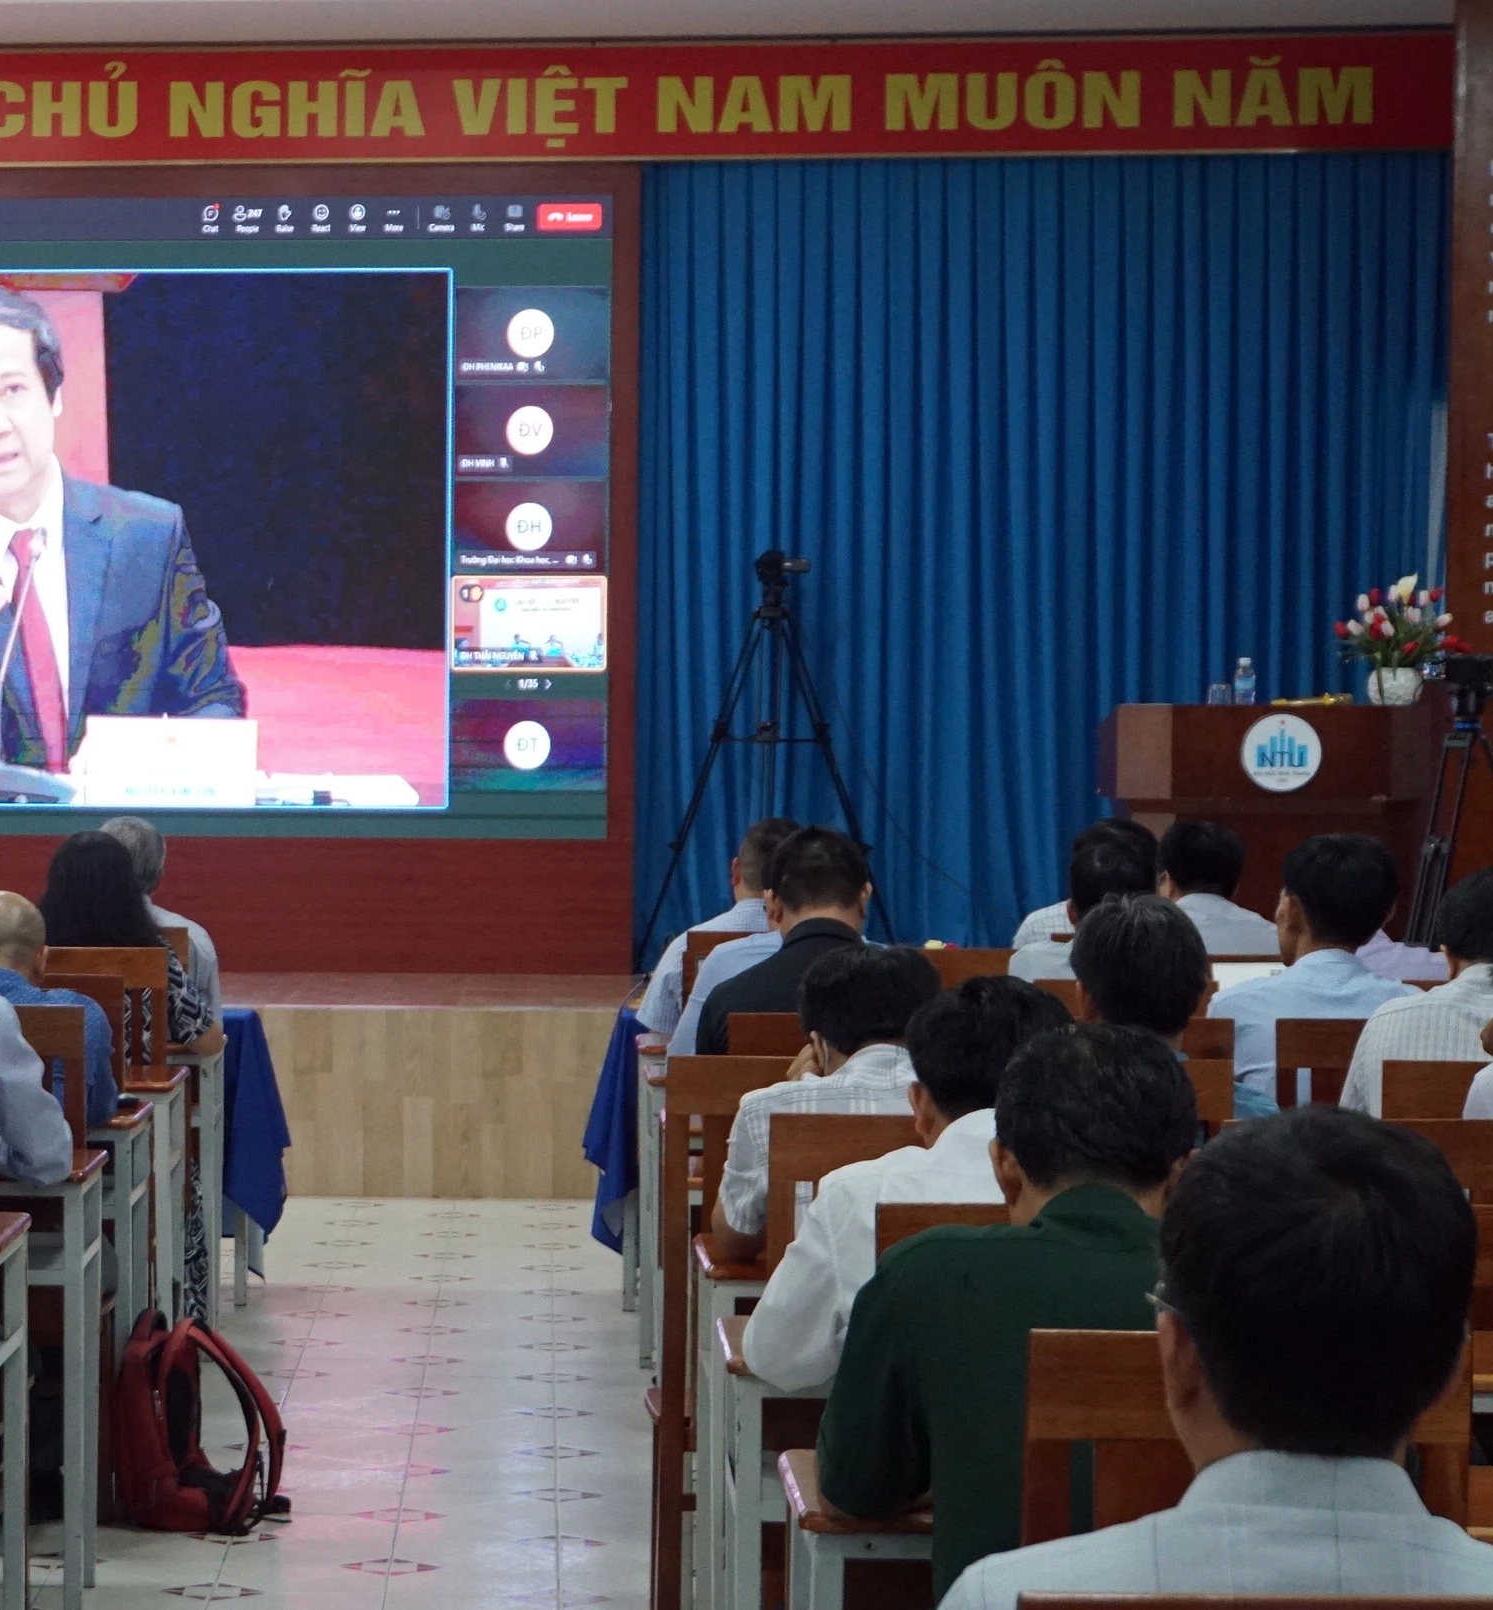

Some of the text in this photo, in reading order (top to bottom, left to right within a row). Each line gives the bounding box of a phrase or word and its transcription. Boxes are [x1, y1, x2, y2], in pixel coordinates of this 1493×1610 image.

[169, 68, 426, 138] NGHĨA
[453, 64, 629, 148] VIỆT
[657, 75, 853, 133] NAM
[885, 59, 1141, 131] MUÔN
[1173, 55, 1374, 128] NĂM
[248, 209, 263, 218] 247
[202, 223, 525, 233] Chat People Raise React View More Camera Mic Share
[475, 459, 494, 468] VINH
[1261, 752, 1303, 767] NTU
